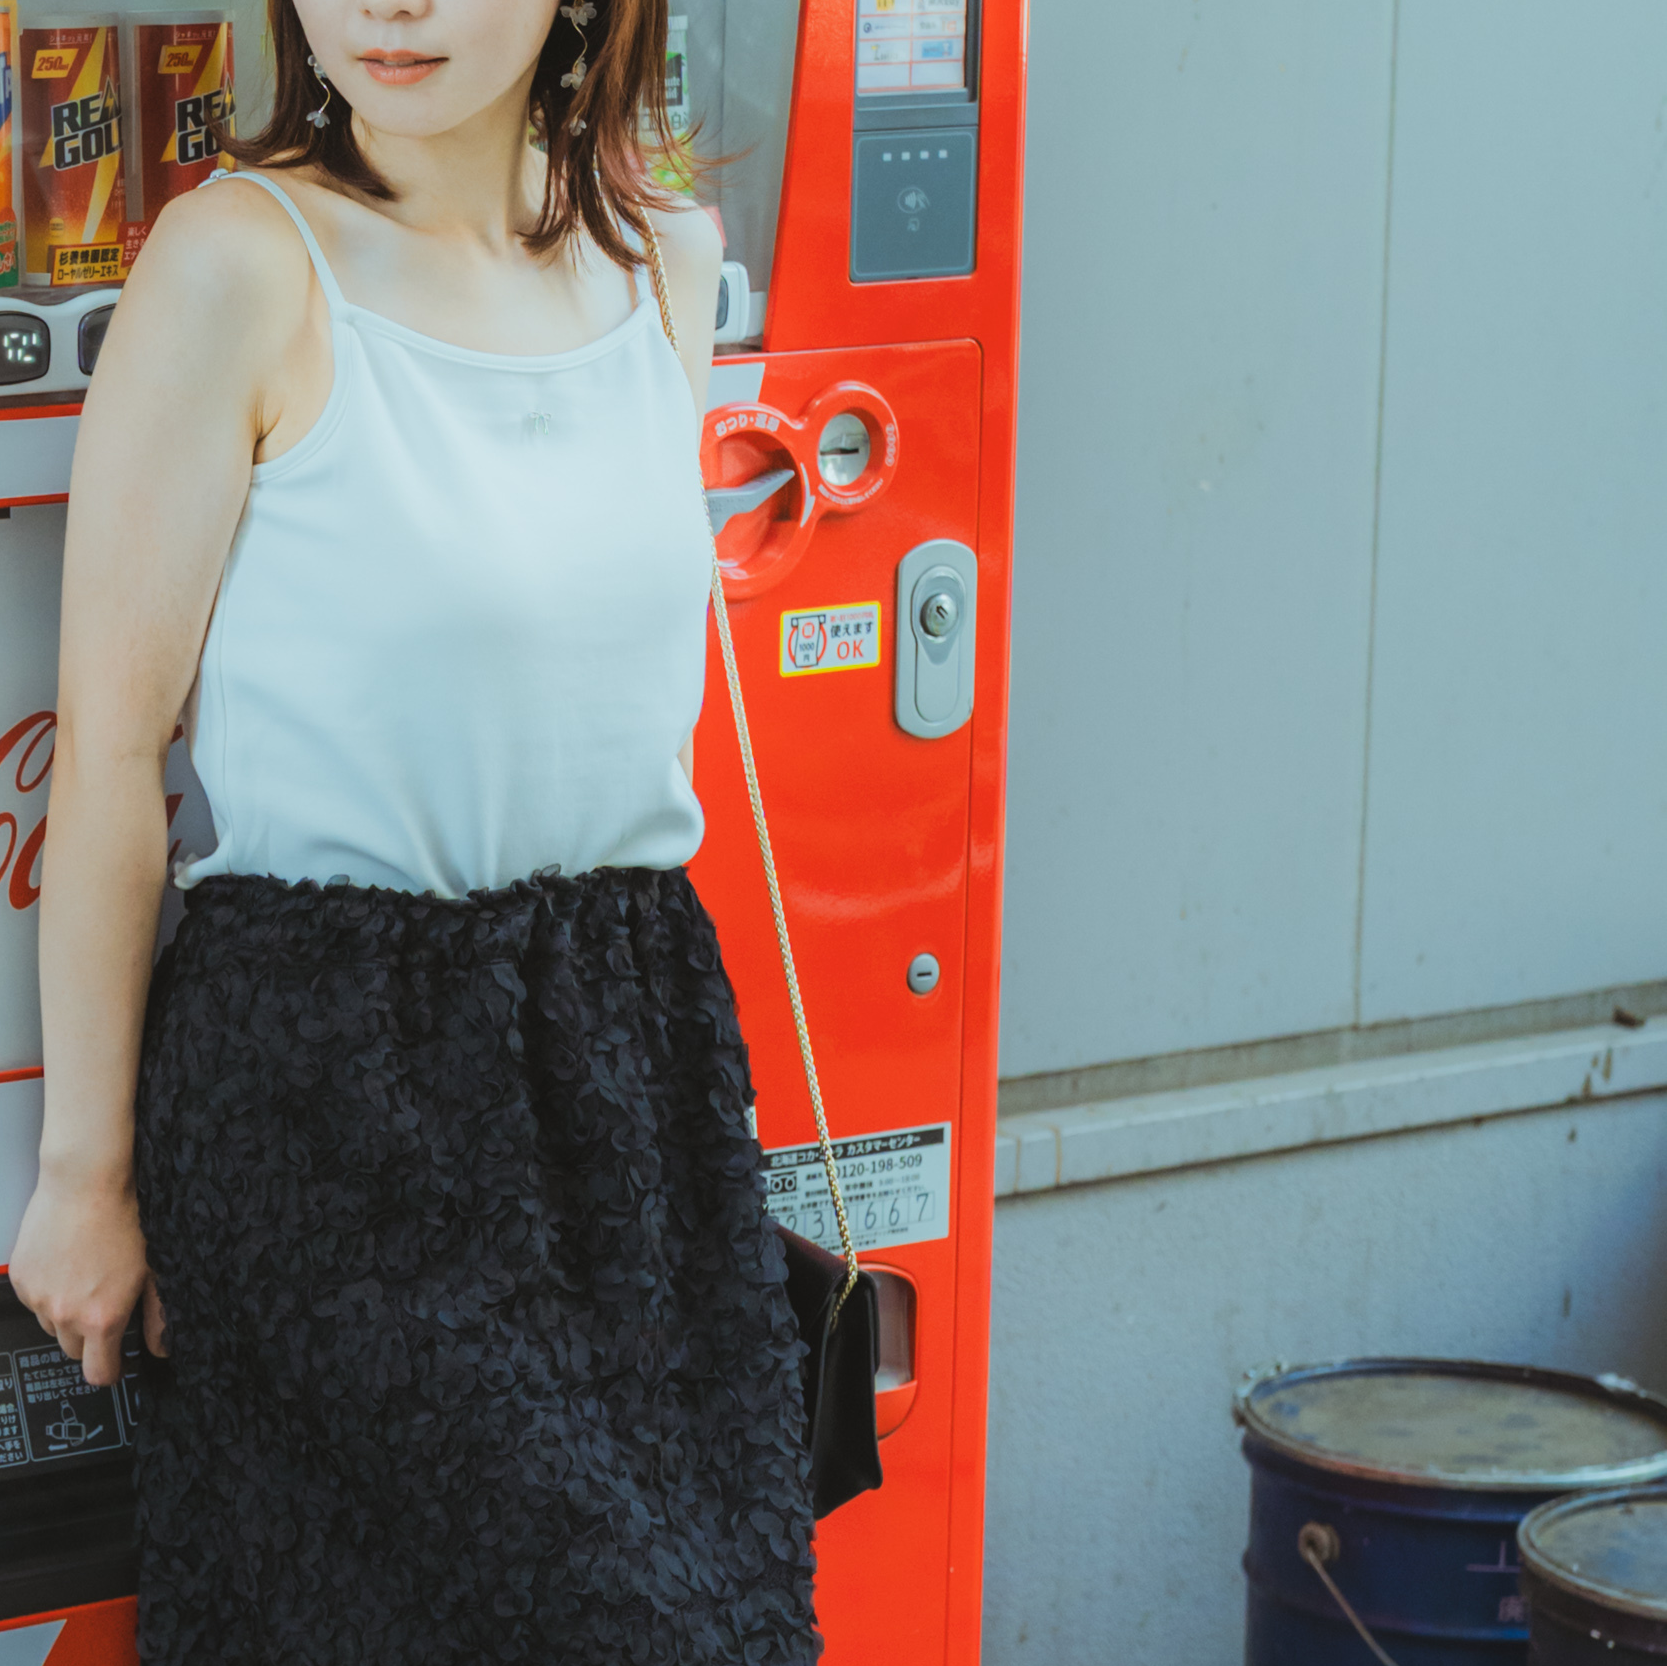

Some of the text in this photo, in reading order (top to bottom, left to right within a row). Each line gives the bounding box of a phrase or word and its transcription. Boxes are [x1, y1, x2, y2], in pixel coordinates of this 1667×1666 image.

[36, 56, 69, 72] 250ml
[165, 51, 194, 68] 250ml
[51, 75, 122, 138] REA
[175, 76, 237, 133] REA
[54, 122, 123, 171] GOL
[176, 127, 225, 166] GO
[59, 248, 120, 266] 杉養蜂園認定
[57, 265, 119, 281] ローヤルゼリーエキス
[831, 621, 874, 638] 使えます
[799, 642, 815, 652] 1000
[836, 639, 864, 660] OK
[770, 1134, 922, 1168] 北海道コカ・ラ カスタマーセンター
